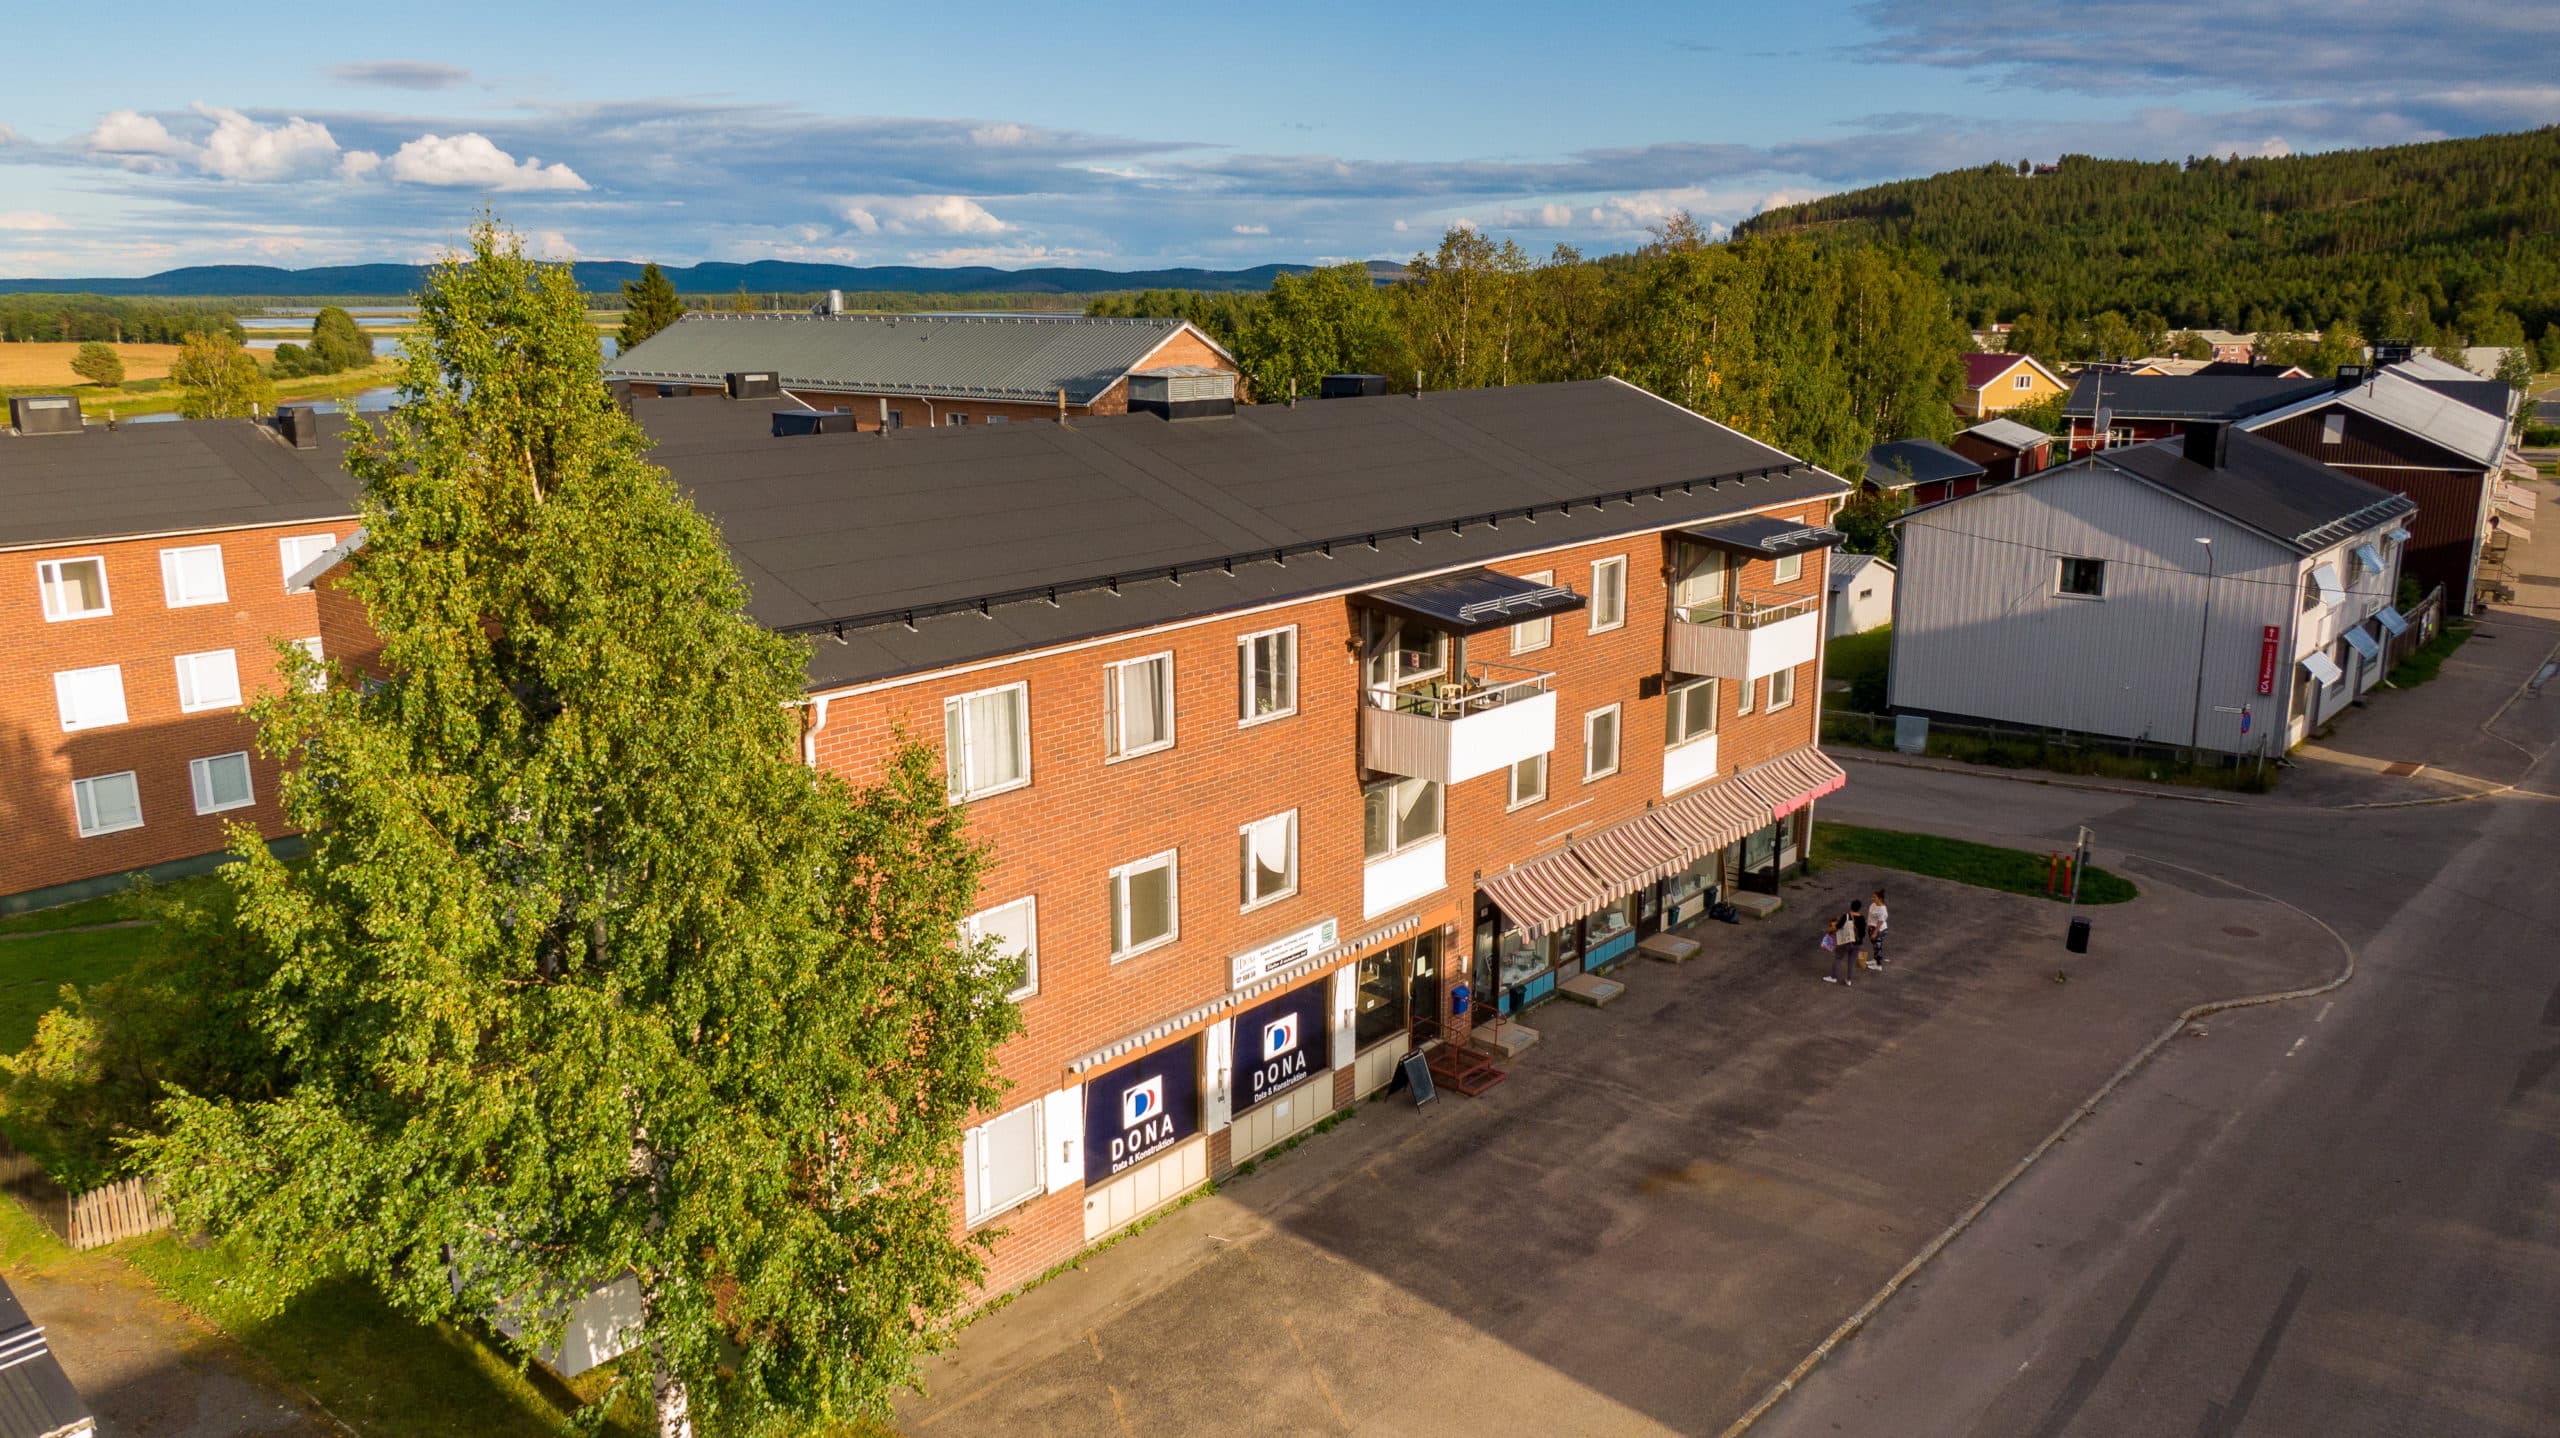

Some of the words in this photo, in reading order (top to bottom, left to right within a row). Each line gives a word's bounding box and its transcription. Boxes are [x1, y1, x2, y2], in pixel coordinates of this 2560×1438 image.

[2260, 680, 2269, 693] ICA
[1254, 1050, 1306, 1091] DONA
[1254, 1092, 1267, 1103] Data
[1268, 1087, 1273, 1096] &
[1273, 1071, 1307, 1093] Konstruktion
[1112, 1114, 1174, 1162] DONA
[1113, 1162, 1128, 1174] Data
[1129, 1155, 1134, 1165] &
[1135, 1137, 1175, 1162] Konstruktion
